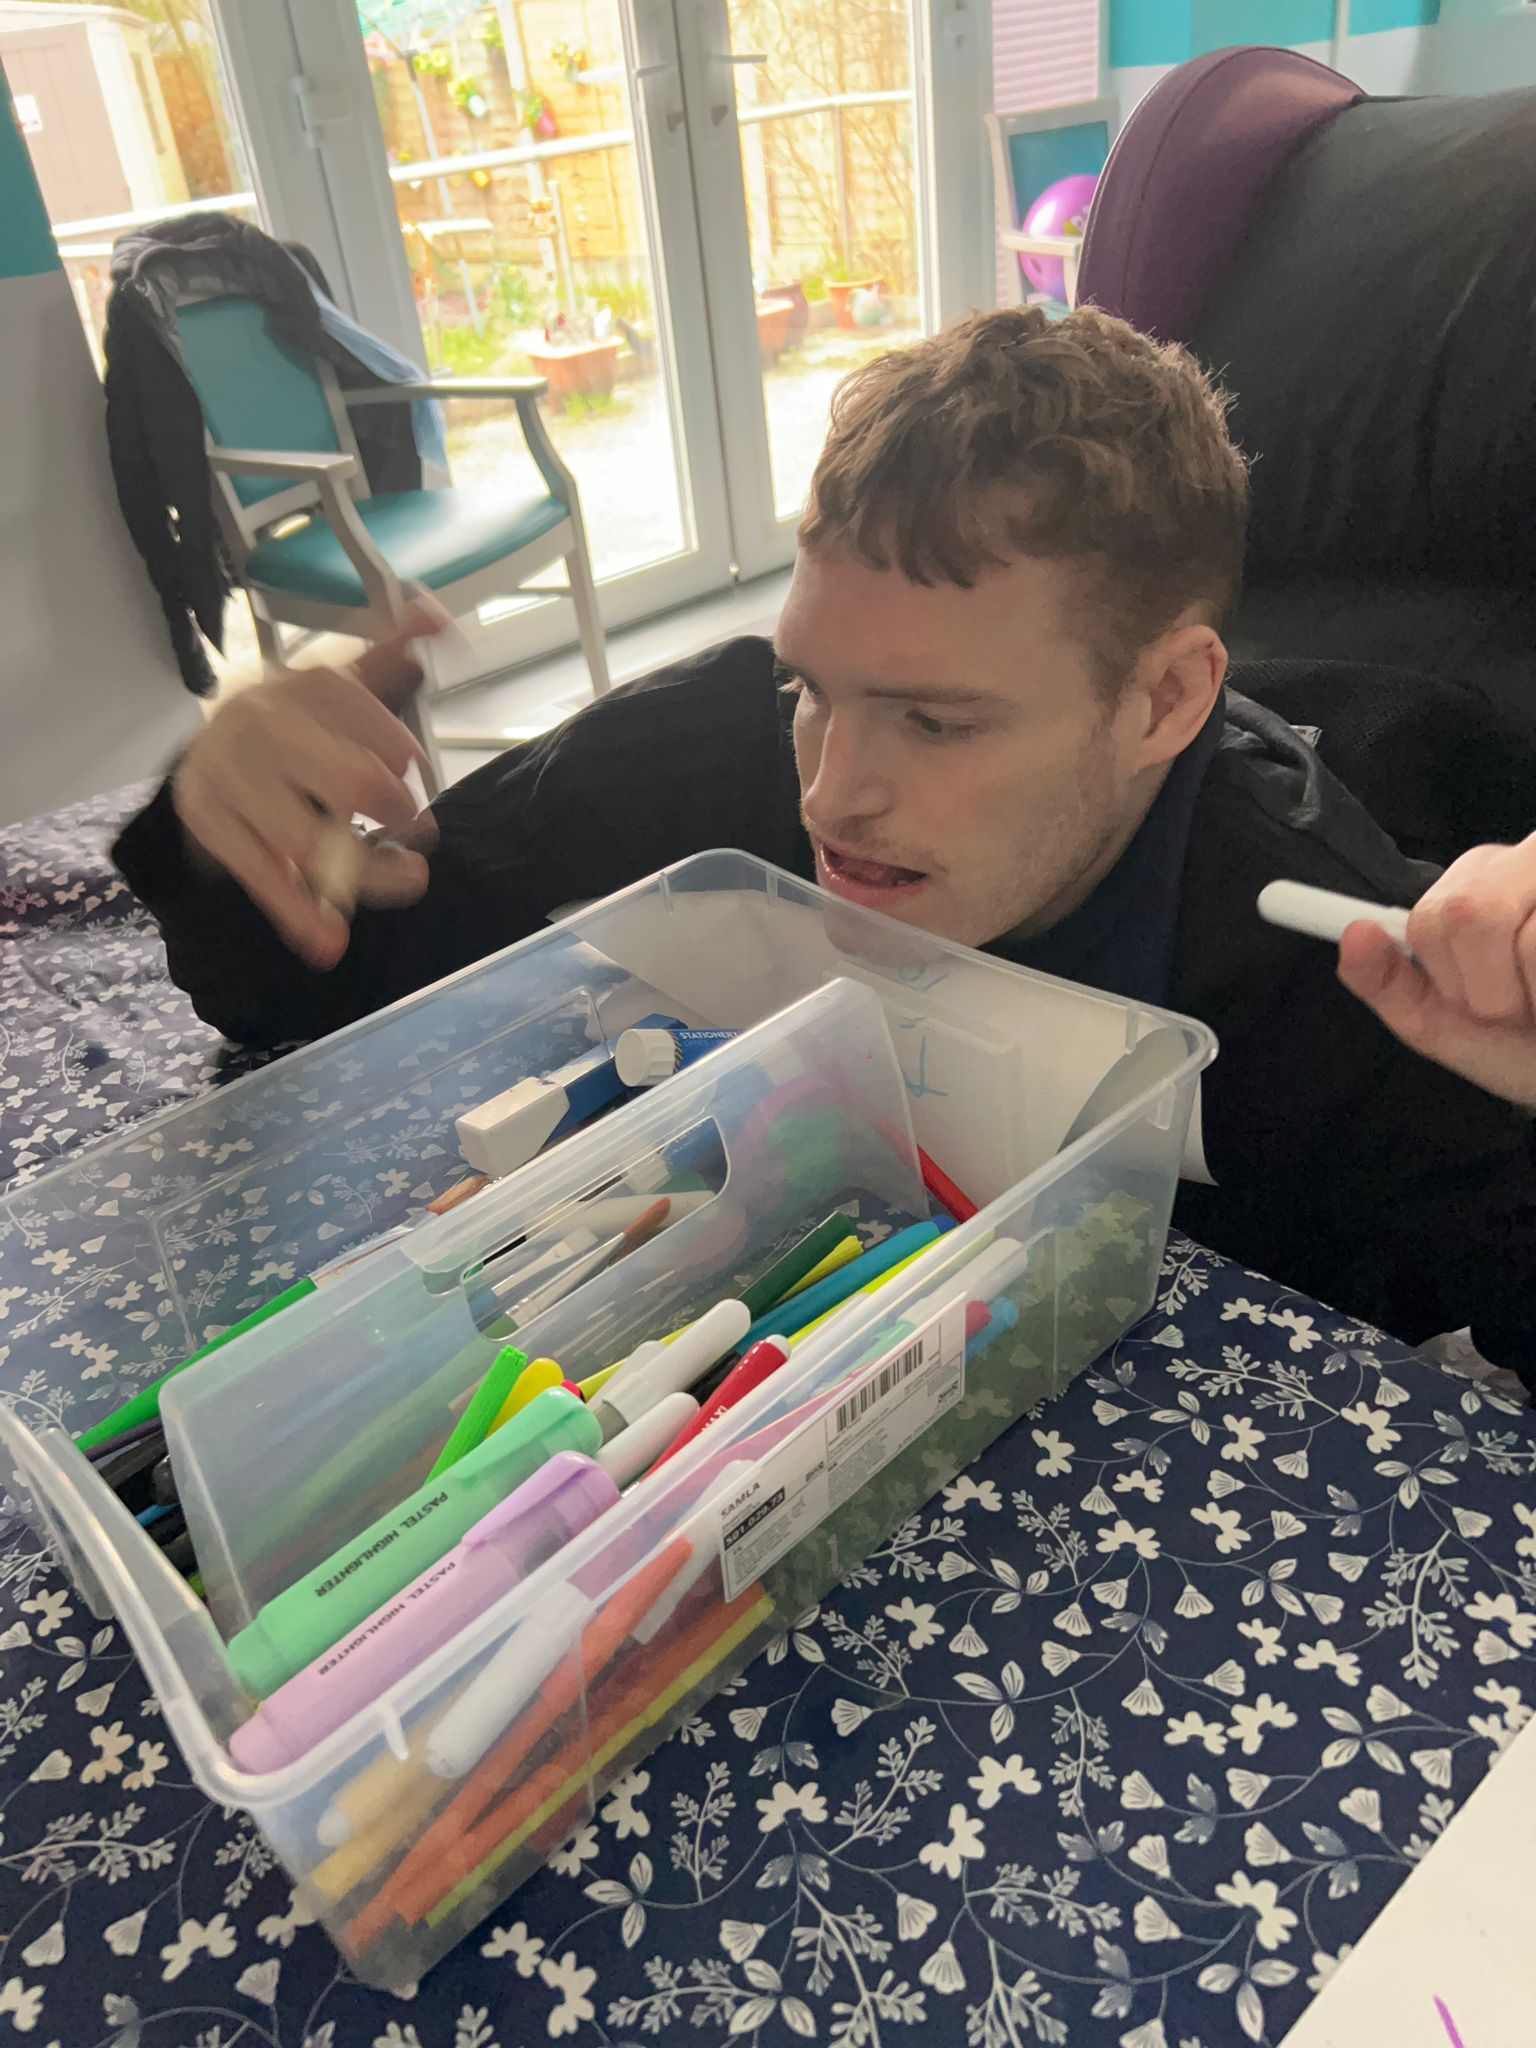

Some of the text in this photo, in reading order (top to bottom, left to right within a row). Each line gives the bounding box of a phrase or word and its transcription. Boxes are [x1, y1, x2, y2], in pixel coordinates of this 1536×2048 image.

[314, 1491, 448, 1597] PASTEL HIGHLIGHTER
[721, 1482, 760, 1515] SAMLA
[318, 1562, 456, 1675] PASTEL HIGHLIGHTER
